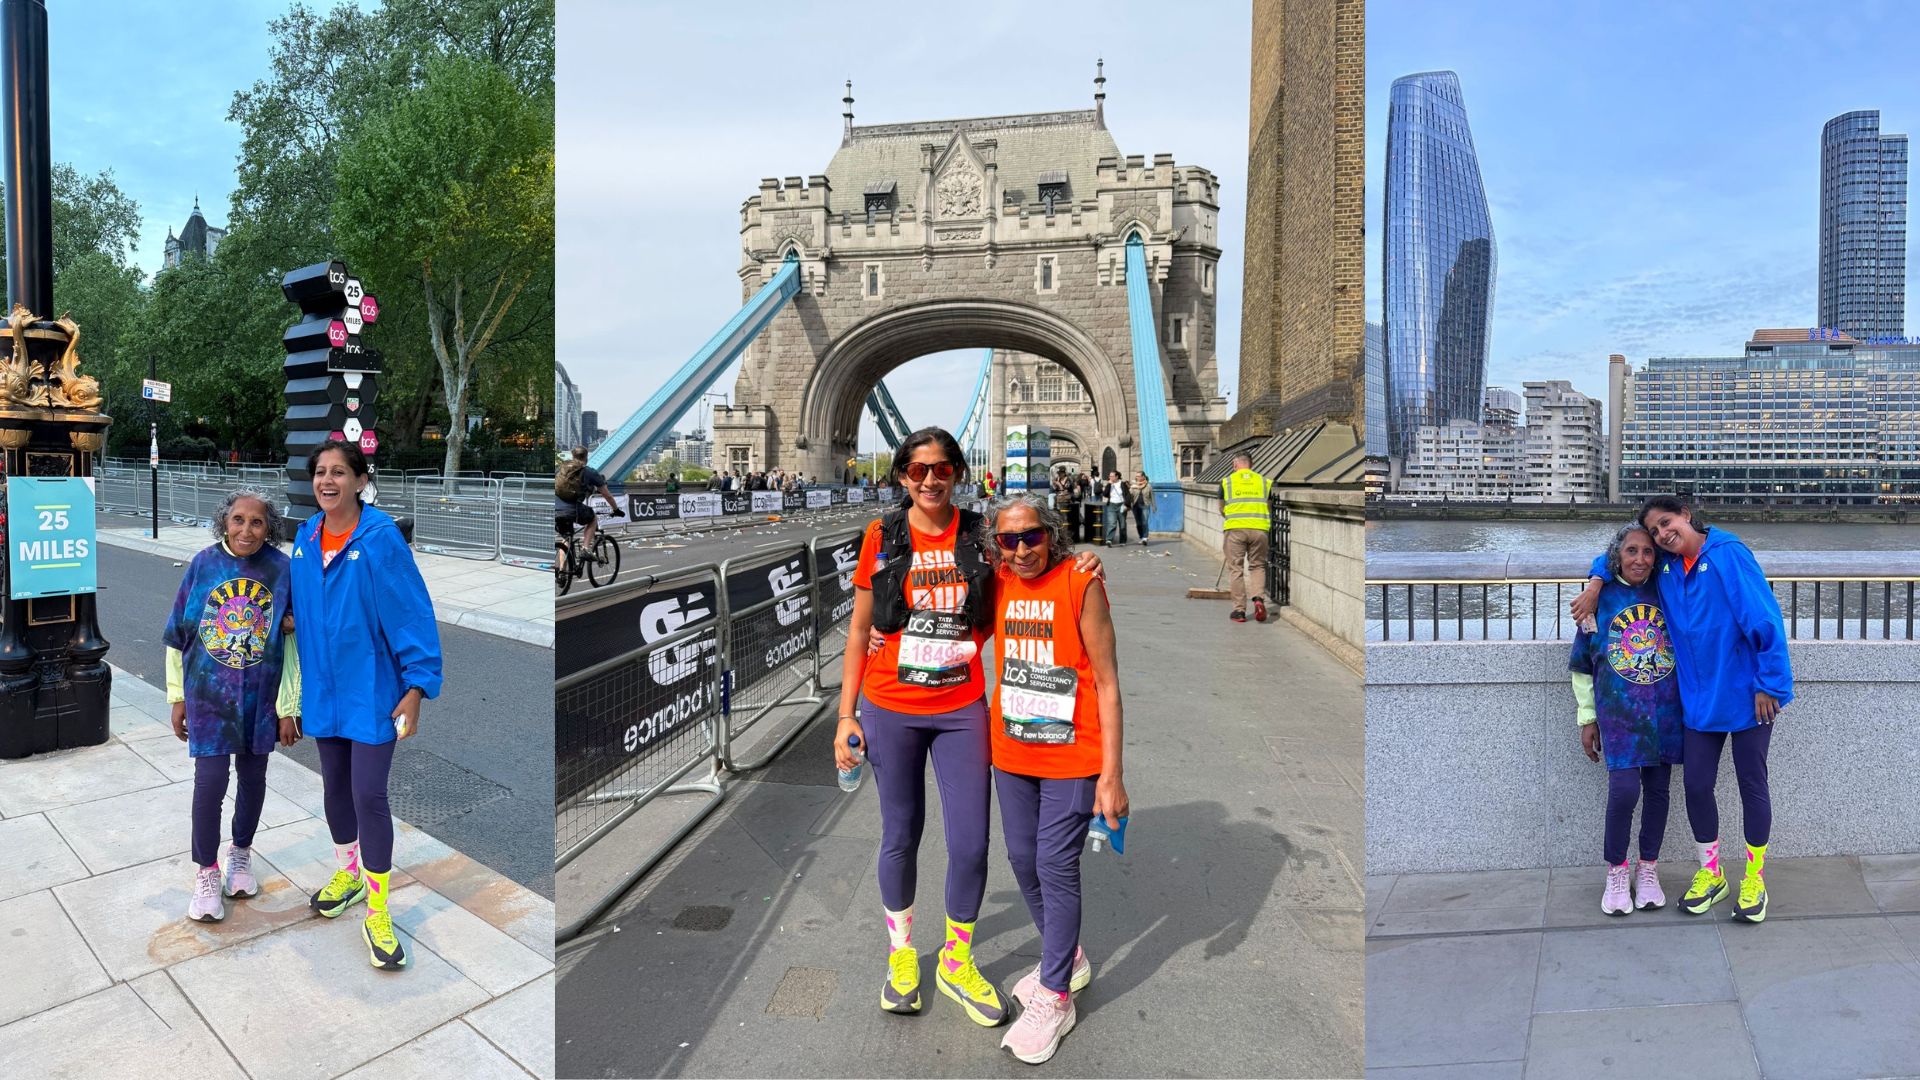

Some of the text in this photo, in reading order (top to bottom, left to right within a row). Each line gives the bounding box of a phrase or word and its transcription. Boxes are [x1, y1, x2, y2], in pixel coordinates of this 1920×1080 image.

[329, 269, 345, 284] tcs
[347, 286, 360, 298] 25
[361, 302, 376, 316] tcs
[346, 317, 361, 325] MILES
[330, 327, 345, 341] tcs
[1809, 327, 1840, 340] SEA
[361, 437, 375, 448] tcs
[633, 499, 654, 517] tcs
[682, 498, 696, 513] tcs
[725, 499, 738, 511] tcs
[39, 511, 69, 531] 25
[20, 539, 89, 561] MILES
[911, 550, 956, 570] ASIA
[911, 570, 964, 587] WOME
[1005, 600, 1054, 620] ASIAN
[908, 614, 934, 633] tcs
[1005, 621, 1053, 638] WOMEN
[1004, 639, 1054, 665] RUN
[1004, 662, 1027, 684] tcs
[1030, 667, 1048, 675] TATA
[942, 675, 967, 684] balance
[1029, 673, 1072, 685] CONSULTANCY
[1029, 680, 1056, 690] SERVICES
[1038, 730, 1067, 739] balance
